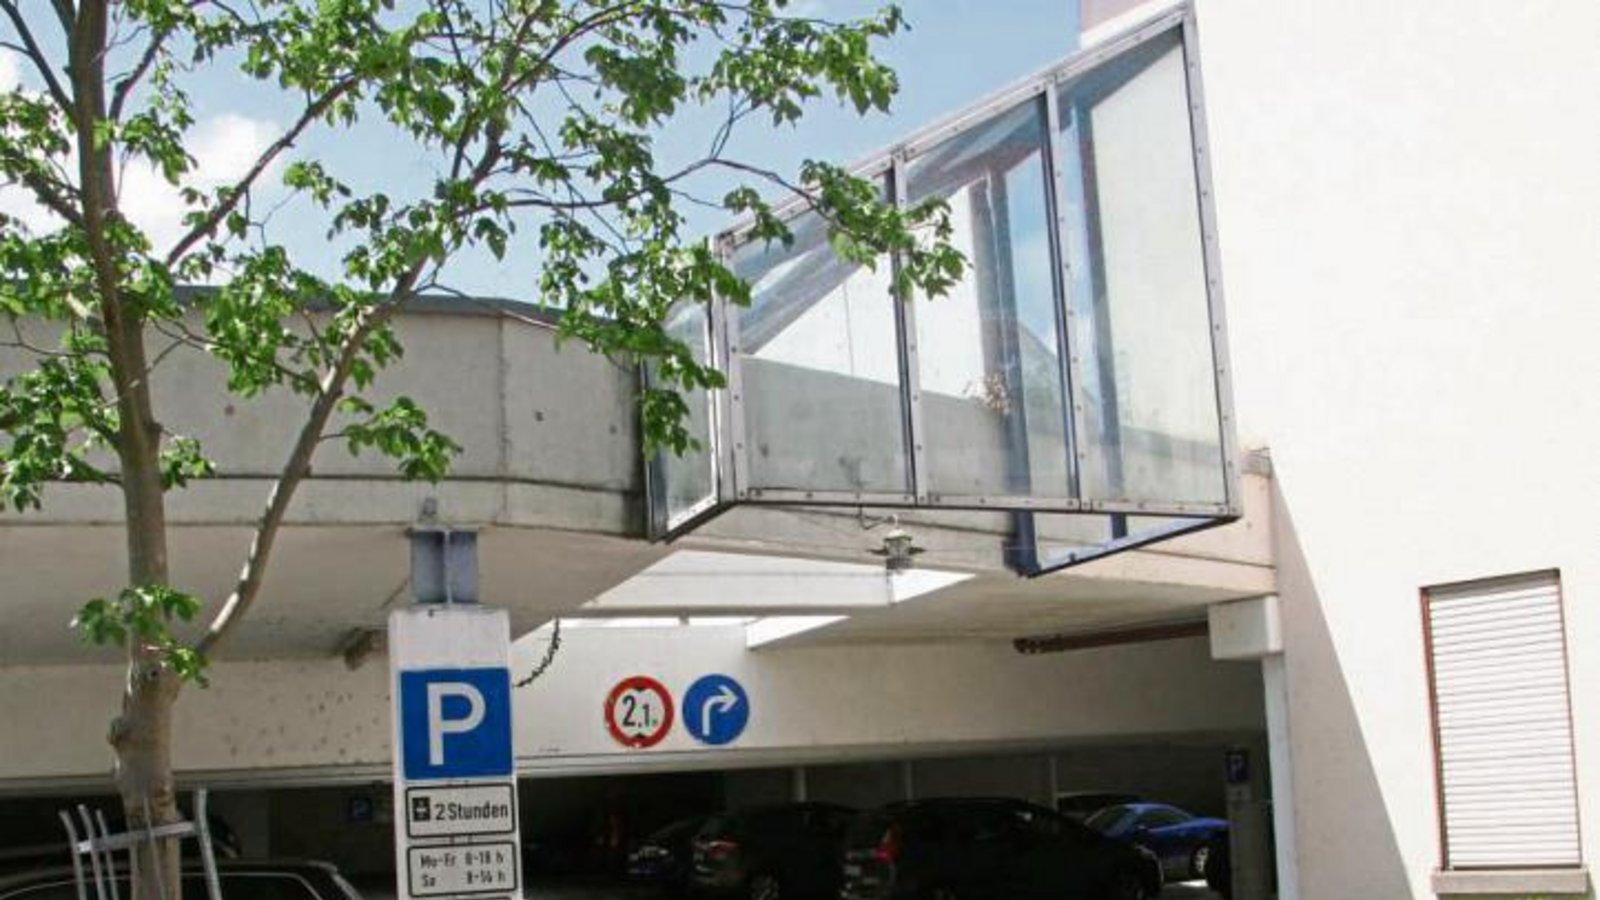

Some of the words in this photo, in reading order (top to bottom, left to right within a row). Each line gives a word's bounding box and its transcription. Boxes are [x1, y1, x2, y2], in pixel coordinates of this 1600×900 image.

[426, 681, 486, 766] P
[434, 803, 446, 821] 2
[447, 800, 508, 820] Stunden
[496, 849, 504, 863] h
[422, 874, 436, 887] Sa
[498, 869, 506, 882] h
